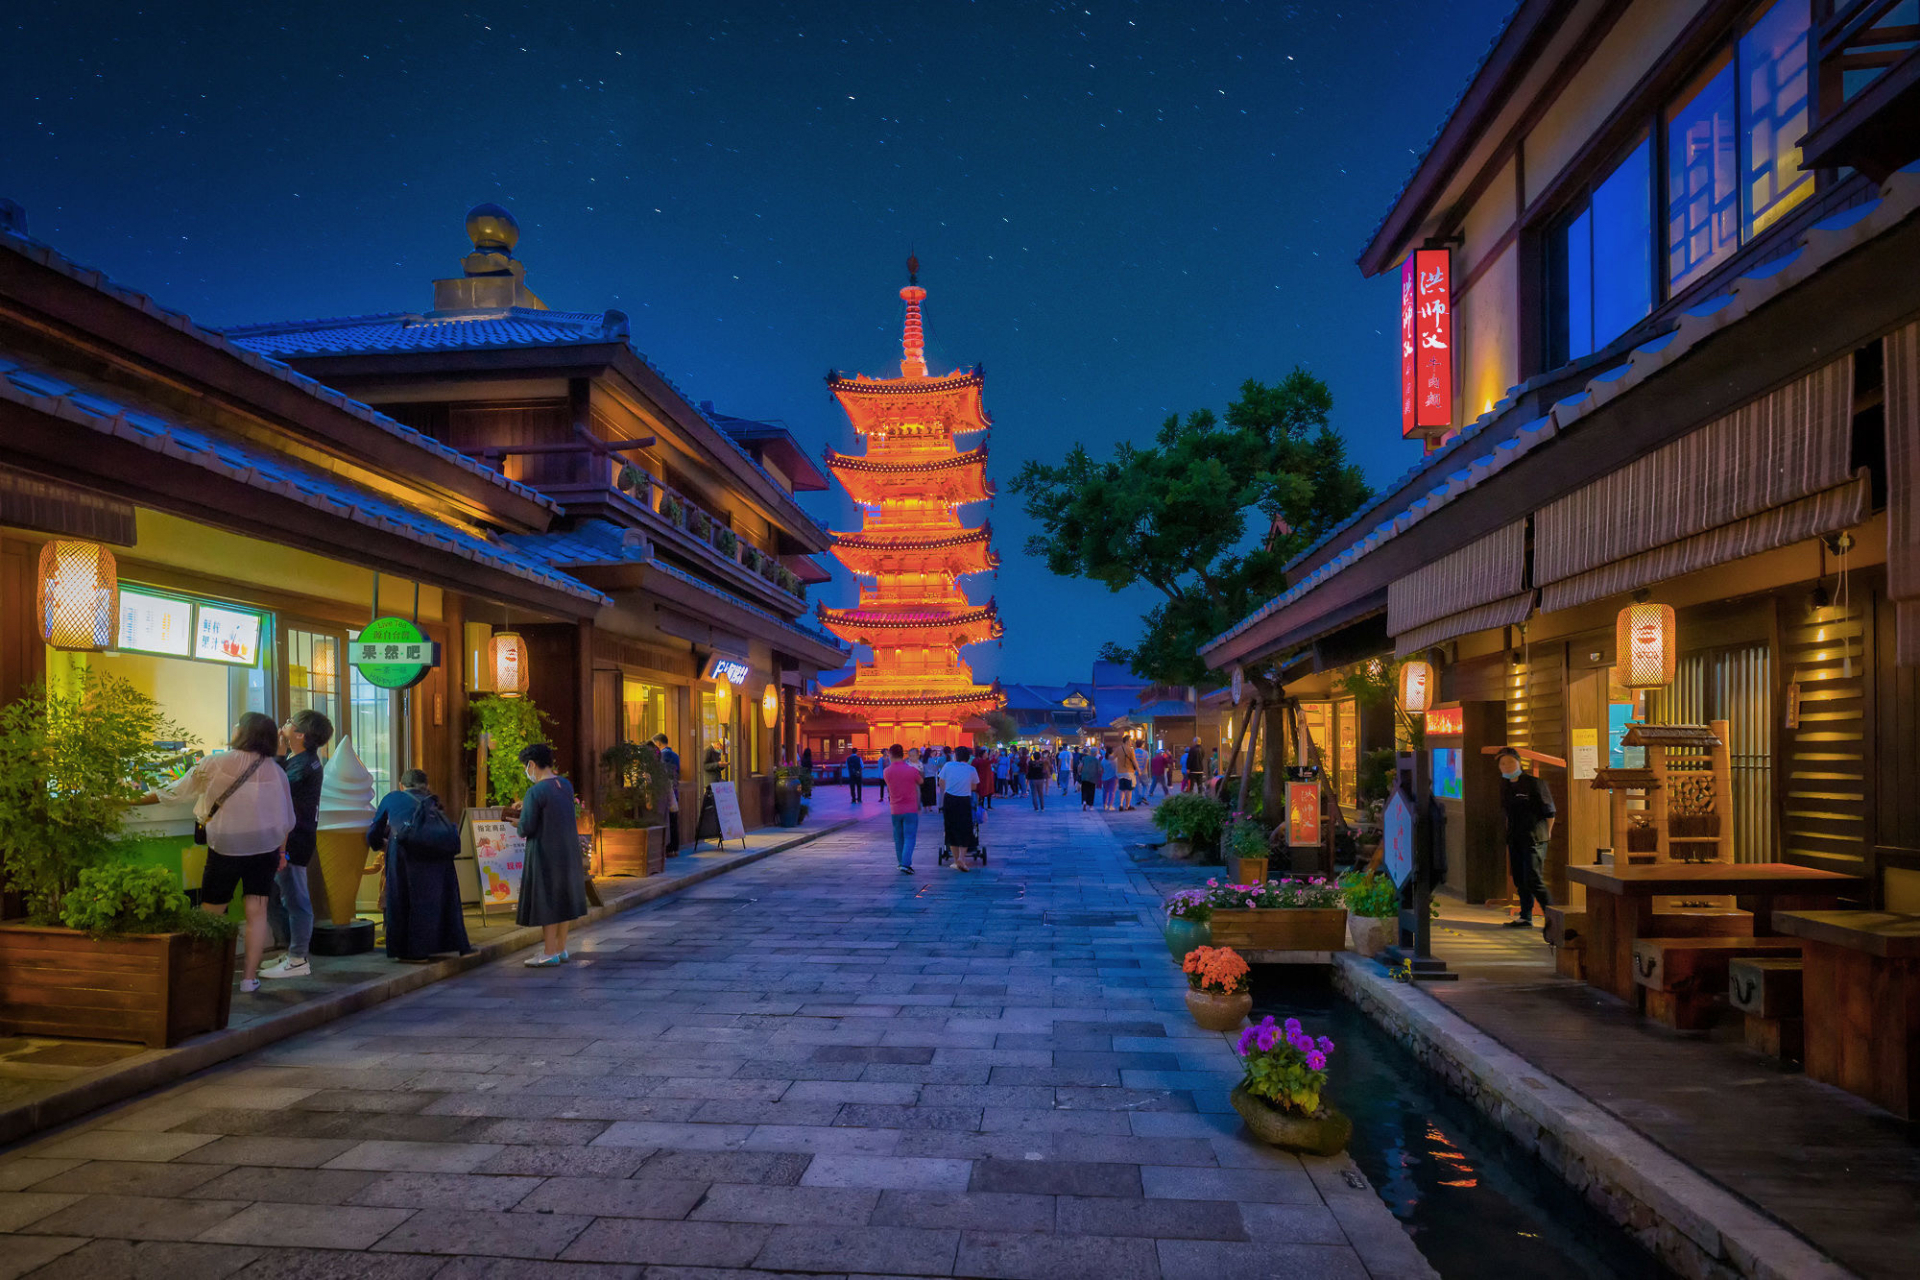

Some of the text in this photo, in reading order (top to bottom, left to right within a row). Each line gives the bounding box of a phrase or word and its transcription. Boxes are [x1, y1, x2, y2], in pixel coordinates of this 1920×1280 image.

[1420, 266, 1448, 348] 洪师父
[395, 620, 407, 629] Tea
[477, 824, 506, 833] 指定商品
